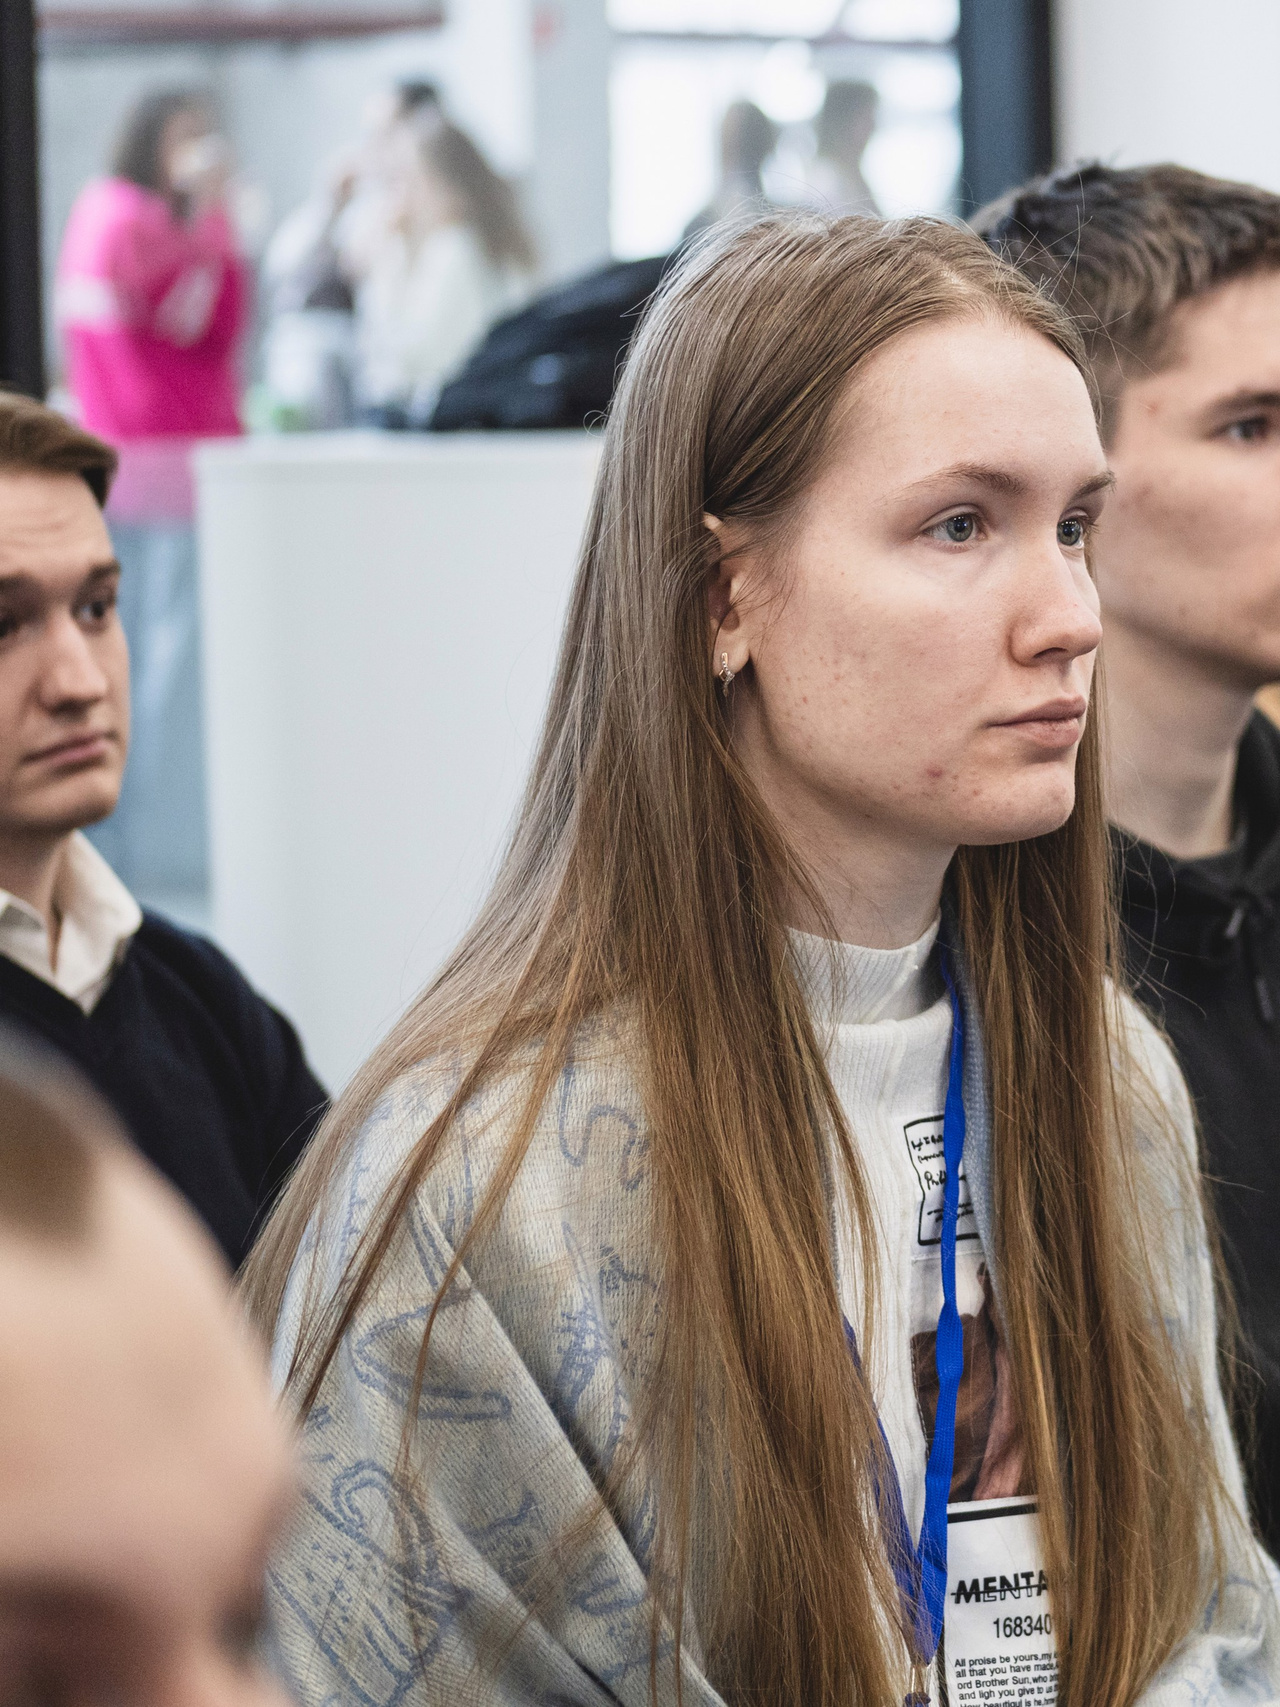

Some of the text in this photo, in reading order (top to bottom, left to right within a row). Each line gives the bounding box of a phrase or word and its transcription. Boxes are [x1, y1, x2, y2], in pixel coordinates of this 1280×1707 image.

[993, 1614, 1052, 1638] 168340
[955, 1658, 966, 1667] All
[999, 1655, 1010, 1663] be
[956, 1669, 966, 1678] all
[969, 1667, 986, 1677] that
[990, 1667, 1006, 1677] you
[1010, 1664, 1031, 1673] have
[957, 1681, 972, 1689] ord
[975, 1678, 1009, 1689] Brother
[959, 1691, 976, 1700] and
[998, 1689, 1015, 1699] you
[1018, 1686, 1035, 1697] give
[1037, 1686, 1044, 1694] to
[1046, 1685, 1053, 1694] us
[1025, 1698, 1032, 1707] is
